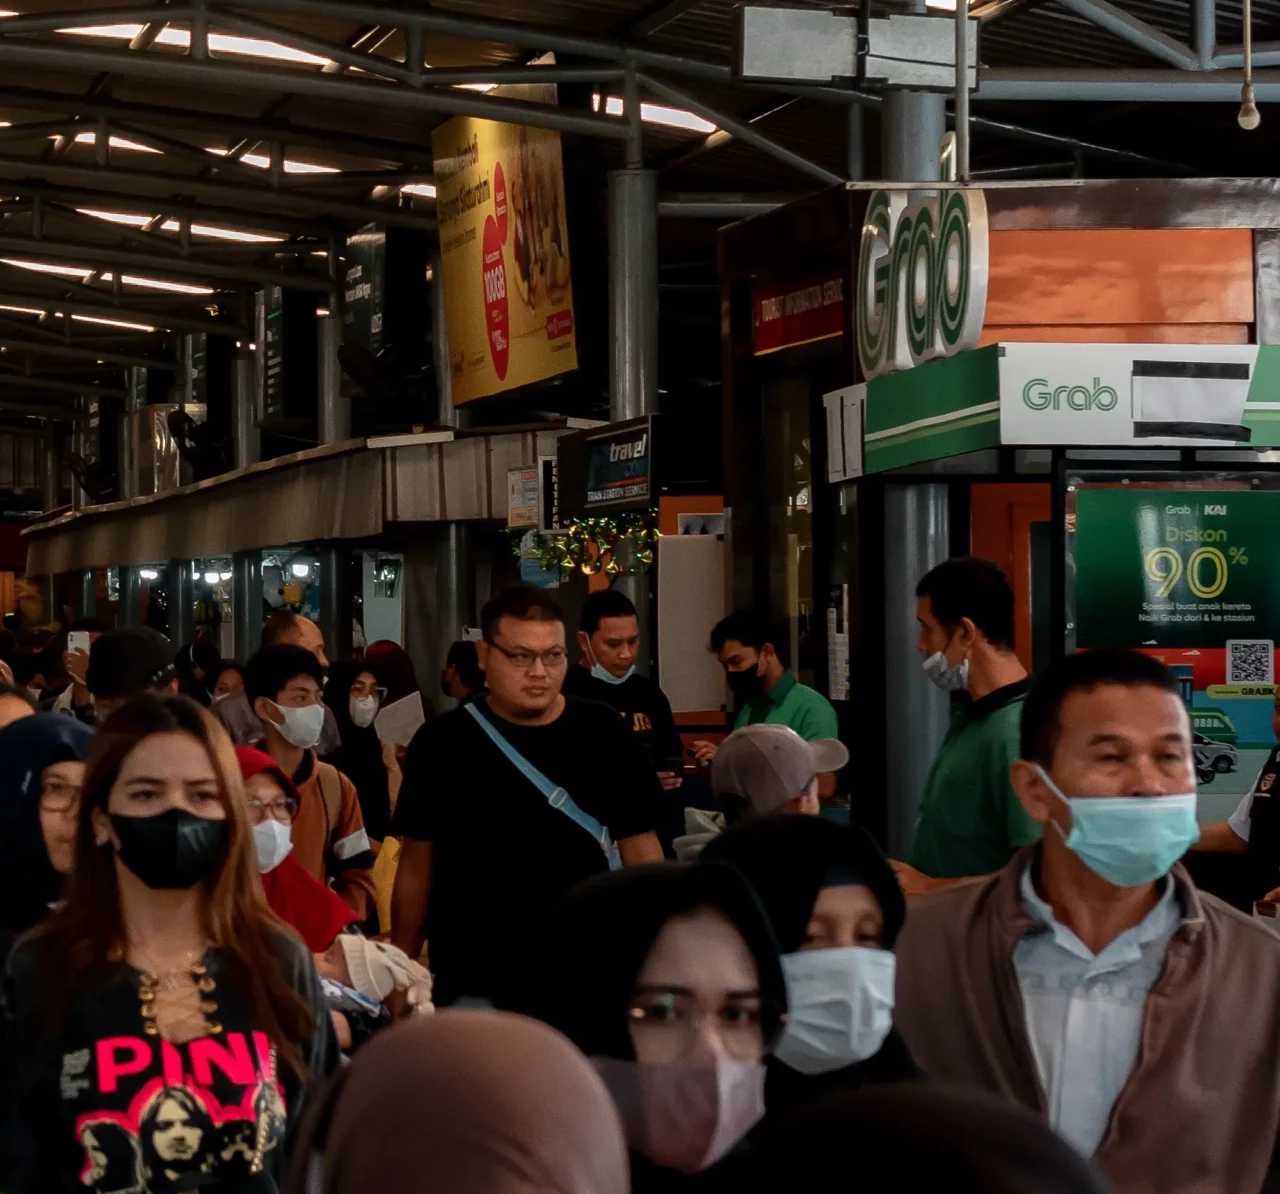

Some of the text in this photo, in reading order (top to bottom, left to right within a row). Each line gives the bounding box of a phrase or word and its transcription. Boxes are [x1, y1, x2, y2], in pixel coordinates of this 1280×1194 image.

[857, 131, 988, 382] Grab
[1022, 376, 1118, 412] Grab
[609, 433, 648, 463] travel
[587, 483, 648, 502] TRAIN STATION SERVICE
[1165, 504, 1227, 516] Grab KAI
[1165, 526, 1227, 542] Diskon
[1142, 602, 1251, 612] Spesial buat anak kereta
[1160, 613, 1182, 621] Grab
[1184, 613, 1202, 621] dari
[1211, 613, 1222, 621] ke
[1223, 613, 1255, 621] stasiun
